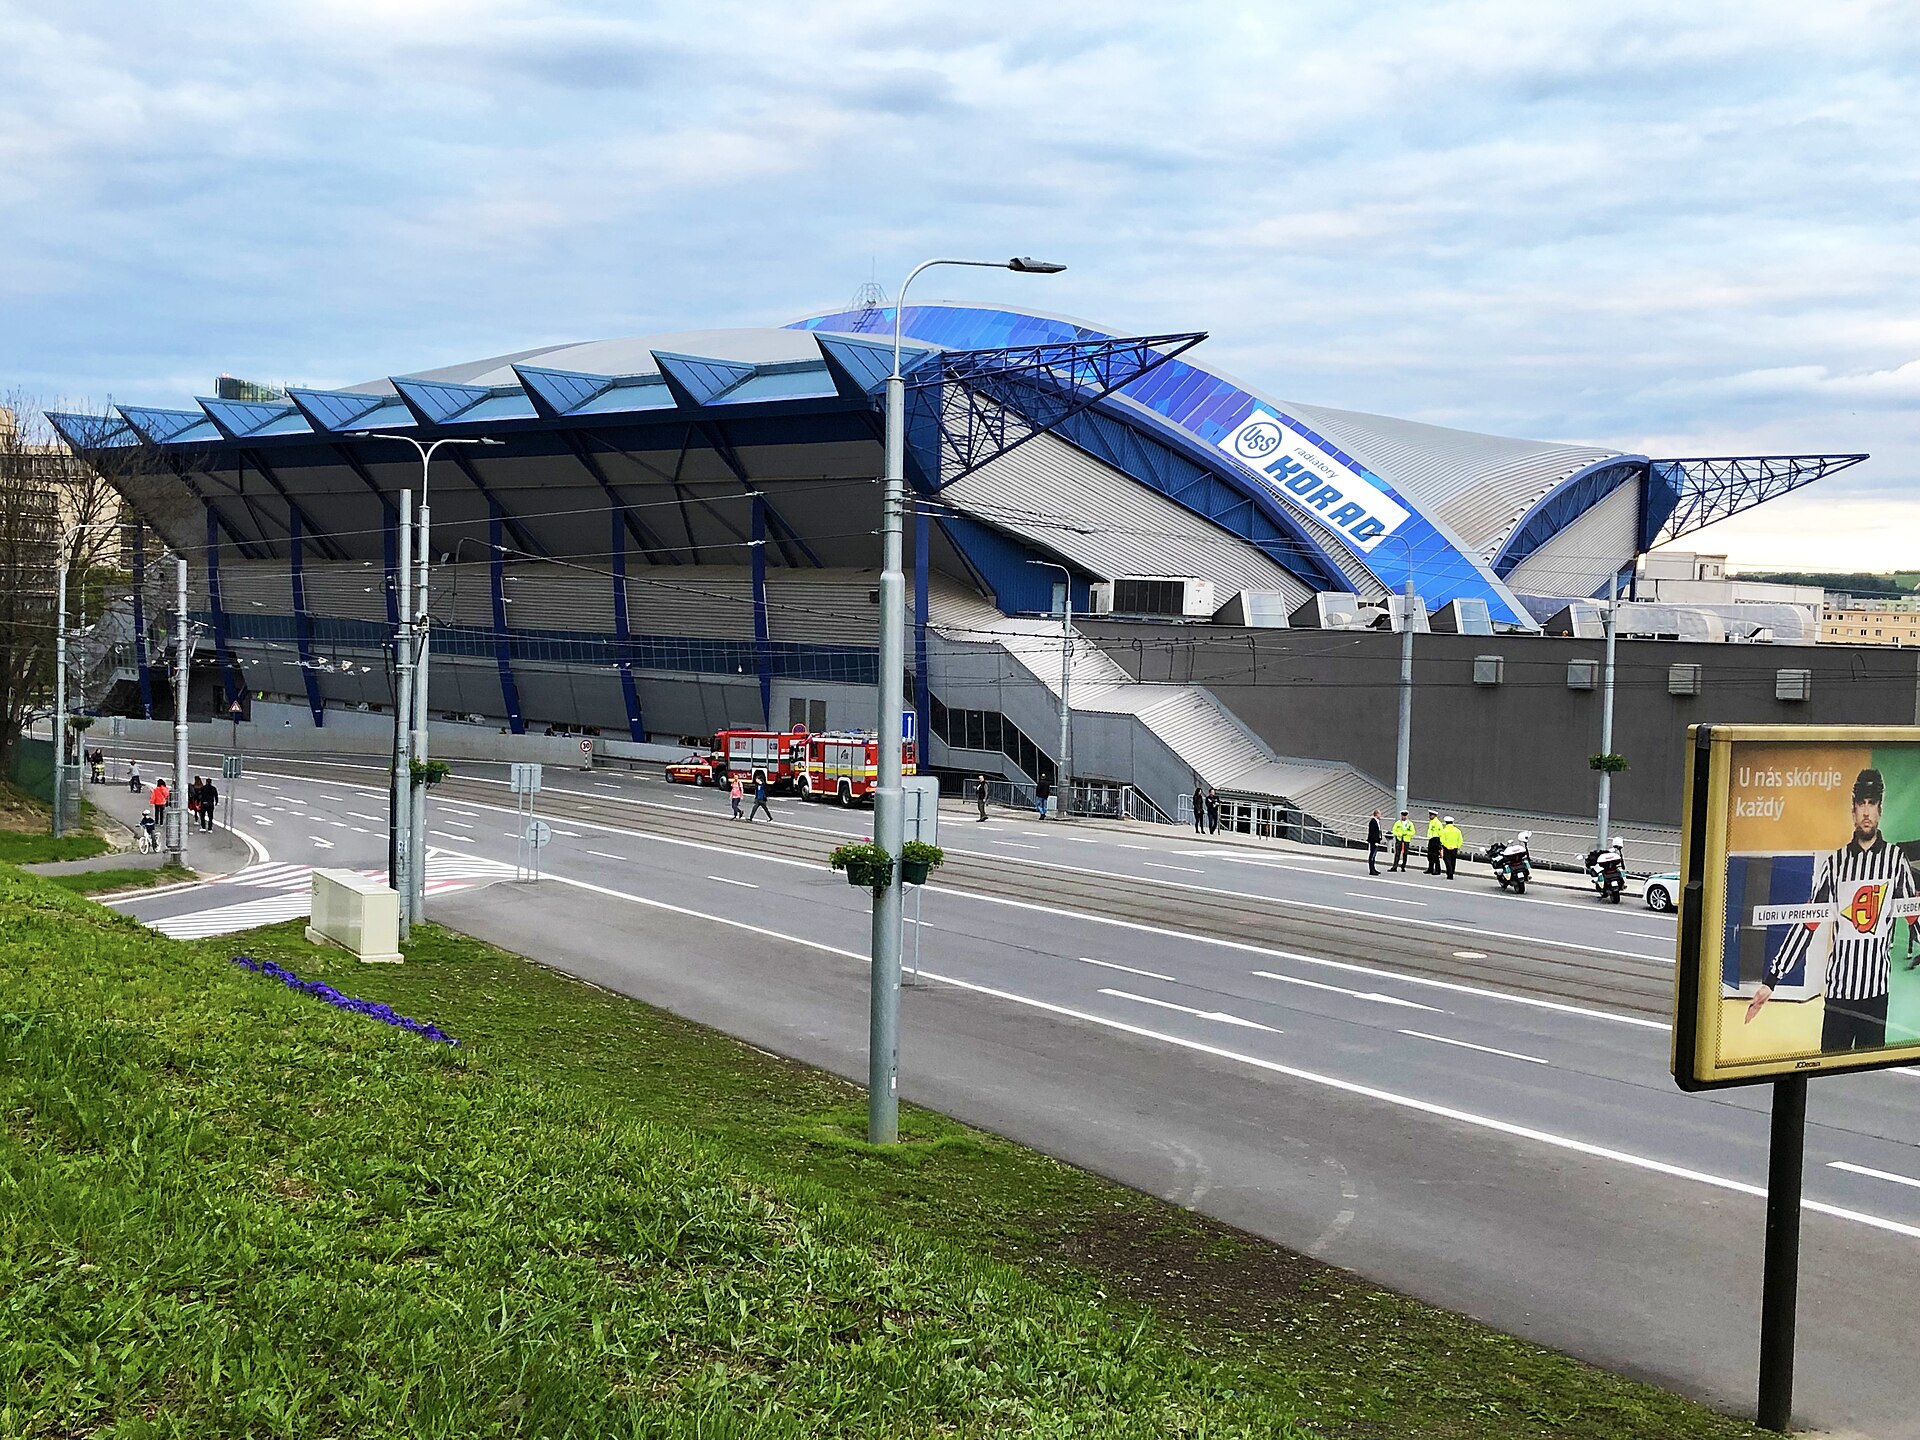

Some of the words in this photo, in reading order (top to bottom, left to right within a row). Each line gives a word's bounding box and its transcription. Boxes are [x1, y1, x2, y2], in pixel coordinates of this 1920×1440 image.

[1243, 426, 1276, 451] USS
[1294, 447, 1339, 479] radiatory
[1263, 454, 1386, 542] KORAD
[1739, 766, 1750, 788] U
[1754, 766, 1783, 787] nás
[1786, 766, 1842, 791] skóruje
[1735, 796, 1785, 821] každý
[1758, 910, 1779, 921] LÍDRI
[1781, 910, 1787, 920] V
[1788, 908, 1830, 919] PRIEMYSLE
[1896, 904, 1902, 913] V
